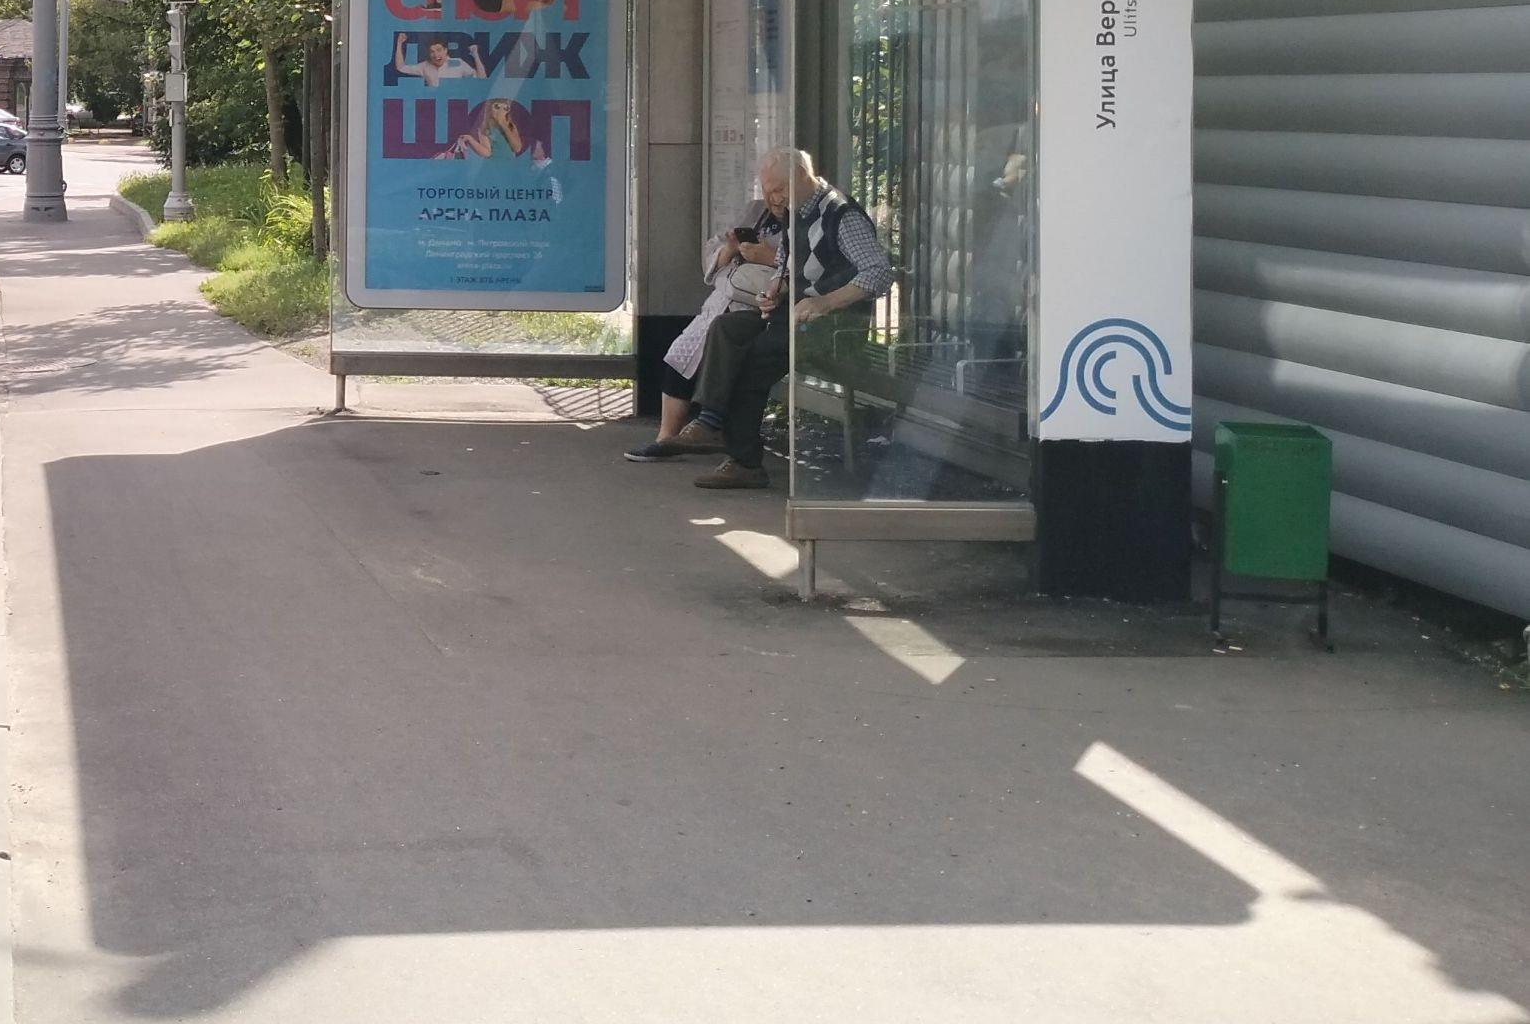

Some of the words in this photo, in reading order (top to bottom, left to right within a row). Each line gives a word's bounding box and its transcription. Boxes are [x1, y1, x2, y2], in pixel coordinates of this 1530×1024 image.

[383, 31, 591, 87] ДВИЖ
[1096, 55, 1118, 129] Улица
[382, 98, 592, 162] ШОП
[417, 186, 500, 200] ТОРГОВЫЙ
[505, 188, 554, 201] ЦЕНТР
[418, 207, 483, 221] АРЕНА
[489, 208, 551, 222] ПЛАЗА
